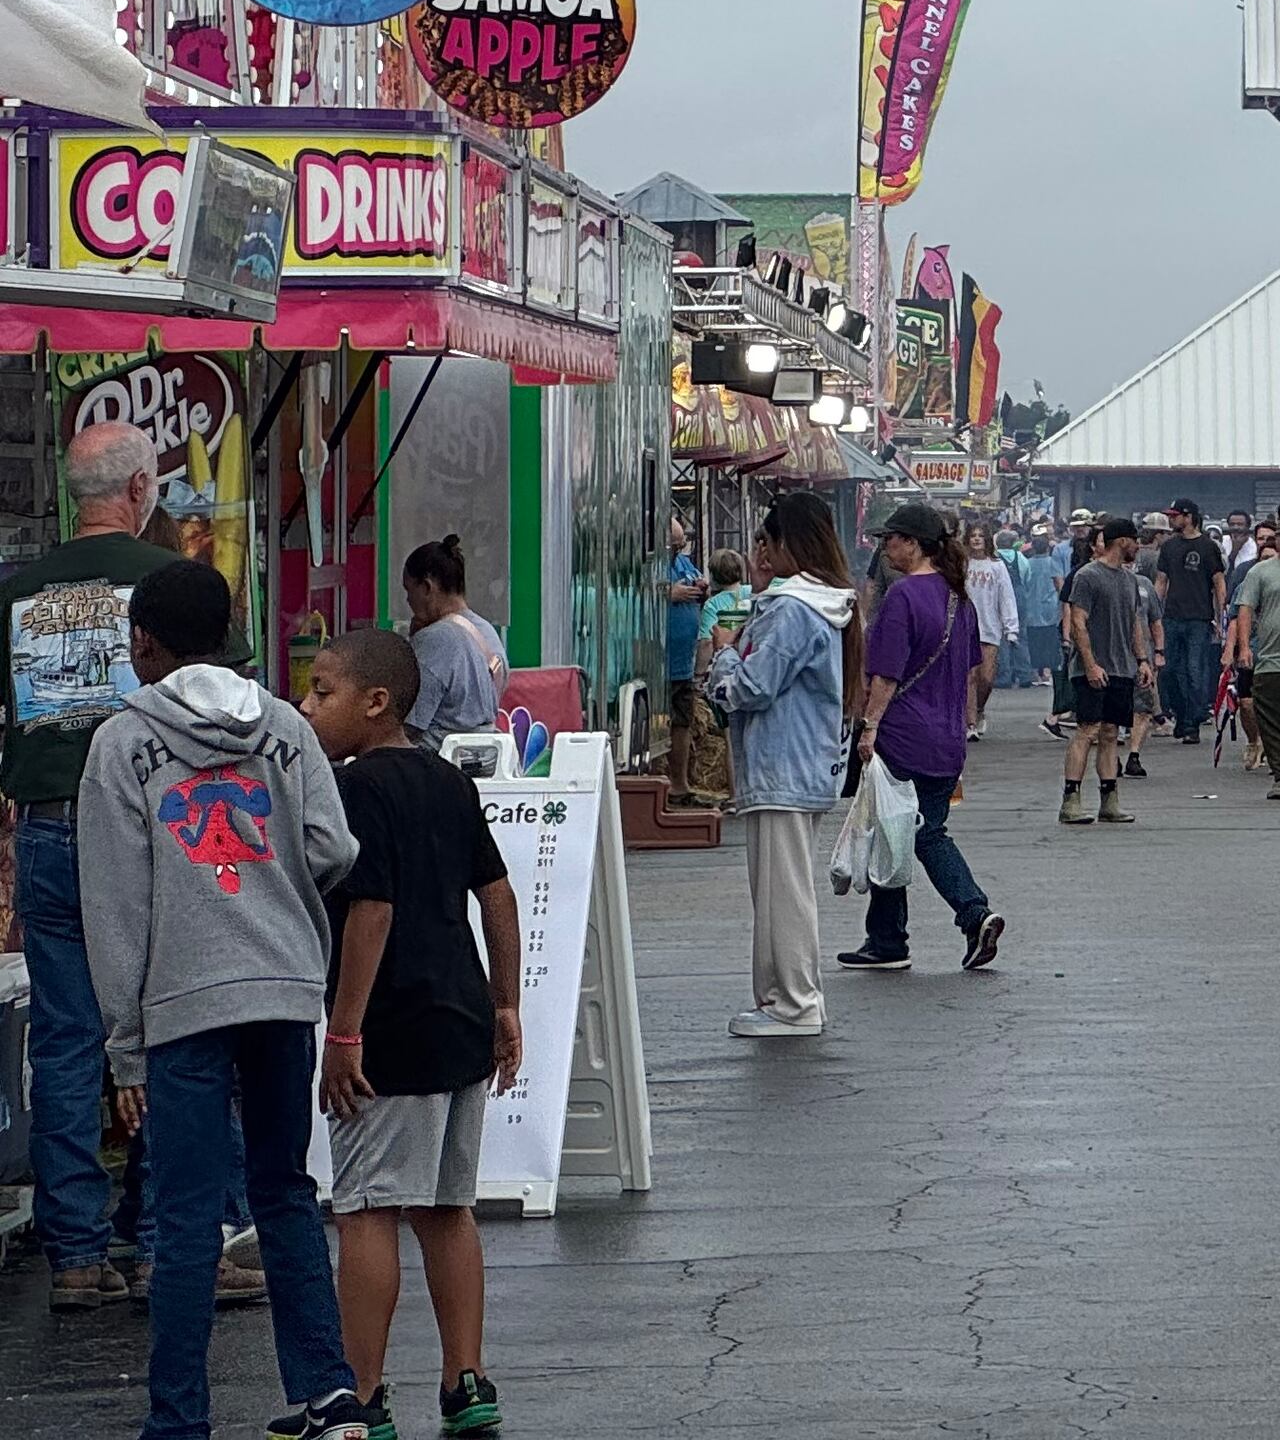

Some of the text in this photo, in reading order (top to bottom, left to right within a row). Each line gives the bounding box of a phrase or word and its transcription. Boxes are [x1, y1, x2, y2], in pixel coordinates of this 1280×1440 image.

[441, 21, 602, 84] APPLE
[900, 58, 930, 151] CAKES
[86, 160, 184, 247] CO
[304, 161, 445, 247] DRINKS
[128, 365, 185, 424] Dr
[483, 802, 538, 824] Cafe
[538, 846, 556, 855] $12
[540, 834, 557, 843] $14
[537, 858, 554, 867] $11
